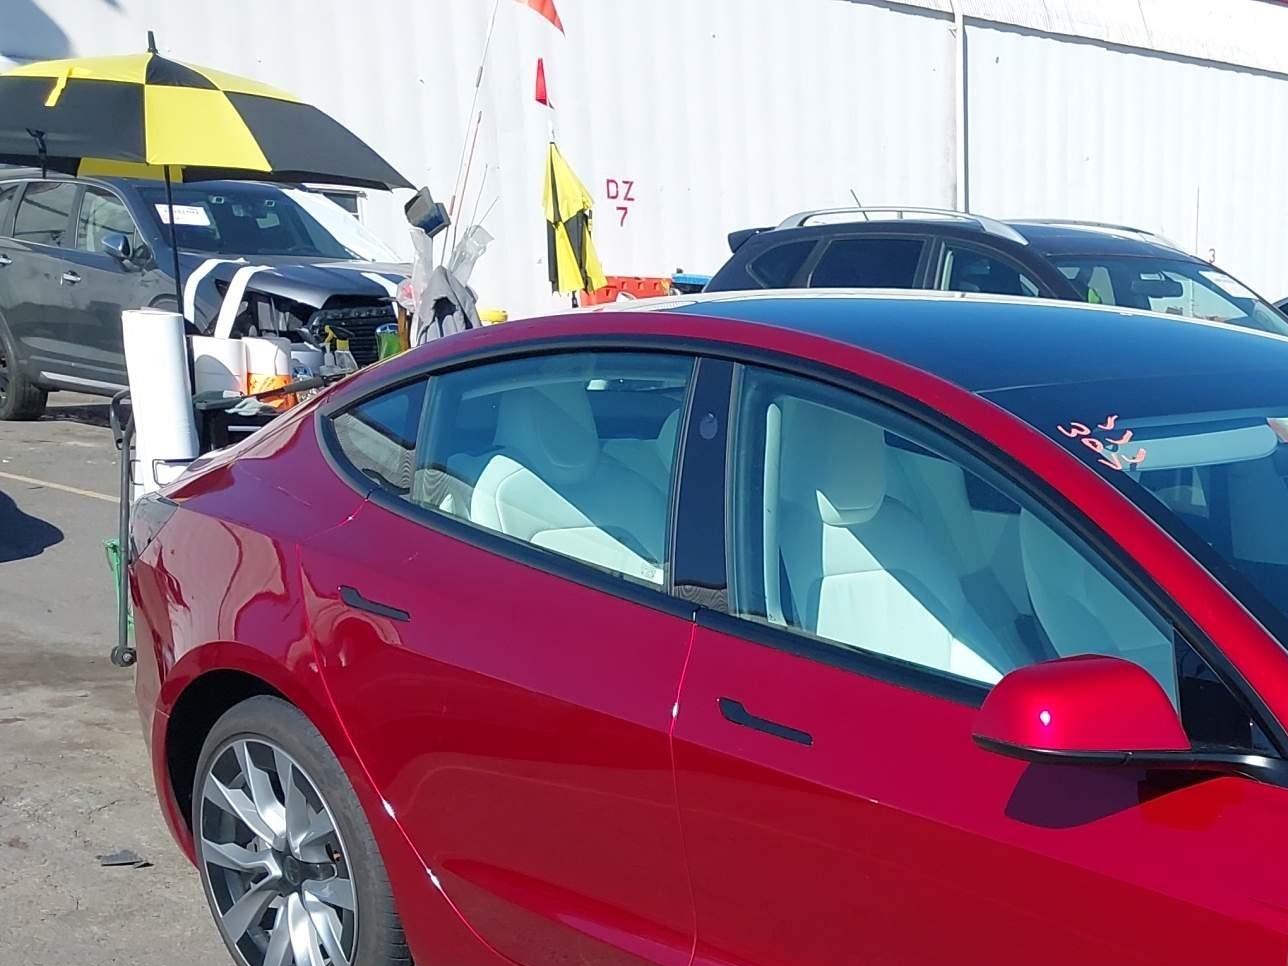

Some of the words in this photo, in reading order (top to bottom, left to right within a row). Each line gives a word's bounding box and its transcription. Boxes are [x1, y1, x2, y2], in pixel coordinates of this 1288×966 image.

[606, 178, 635, 201] DZ
[616, 206, 628, 227] 7
[1208, 248, 1216, 264] 3
